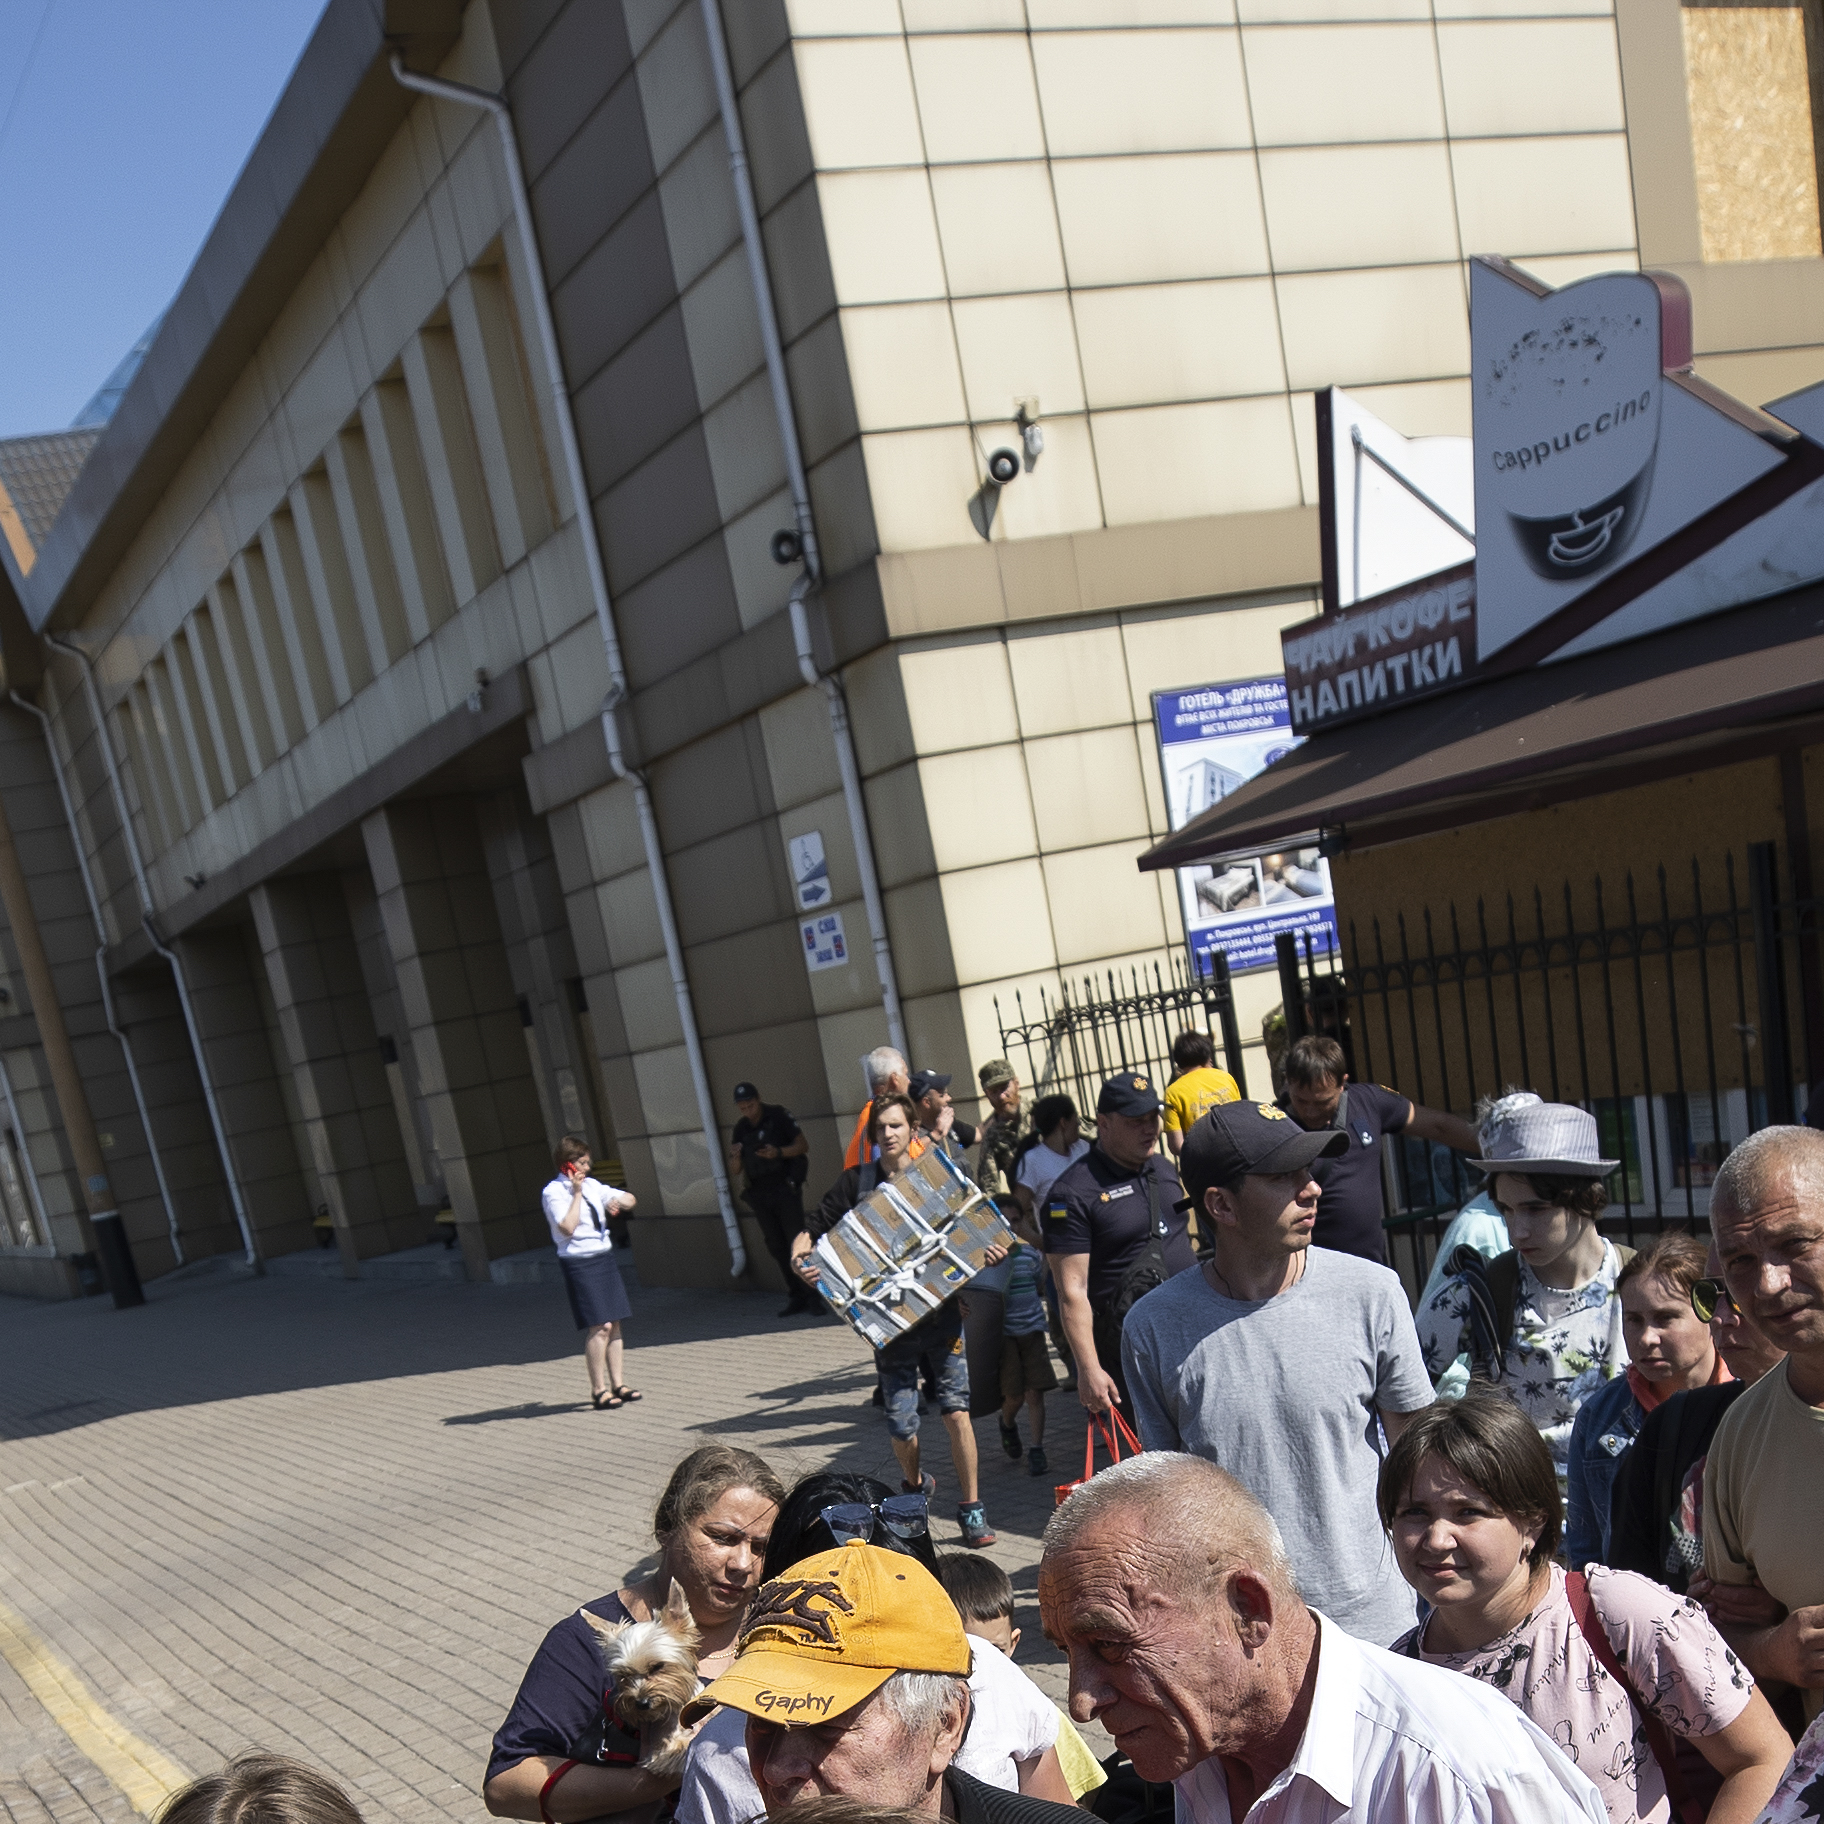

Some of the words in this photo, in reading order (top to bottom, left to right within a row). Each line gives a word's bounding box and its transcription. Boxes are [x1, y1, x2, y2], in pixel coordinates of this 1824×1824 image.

[1493, 390, 1650, 470] Cappuccino
[1179, 690, 1225, 710] ГОТЕЛЬ
[1291, 636, 1463, 726] НАПИТКИ
[1253, 702, 1264, 713] ТА
[1524, 1645, 1569, 1700] Mickey
[1704, 1645, 1717, 1709] Mickey
[754, 1690, 835, 1716] Gaphy
[1586, 1694, 1630, 1744] Mickey
